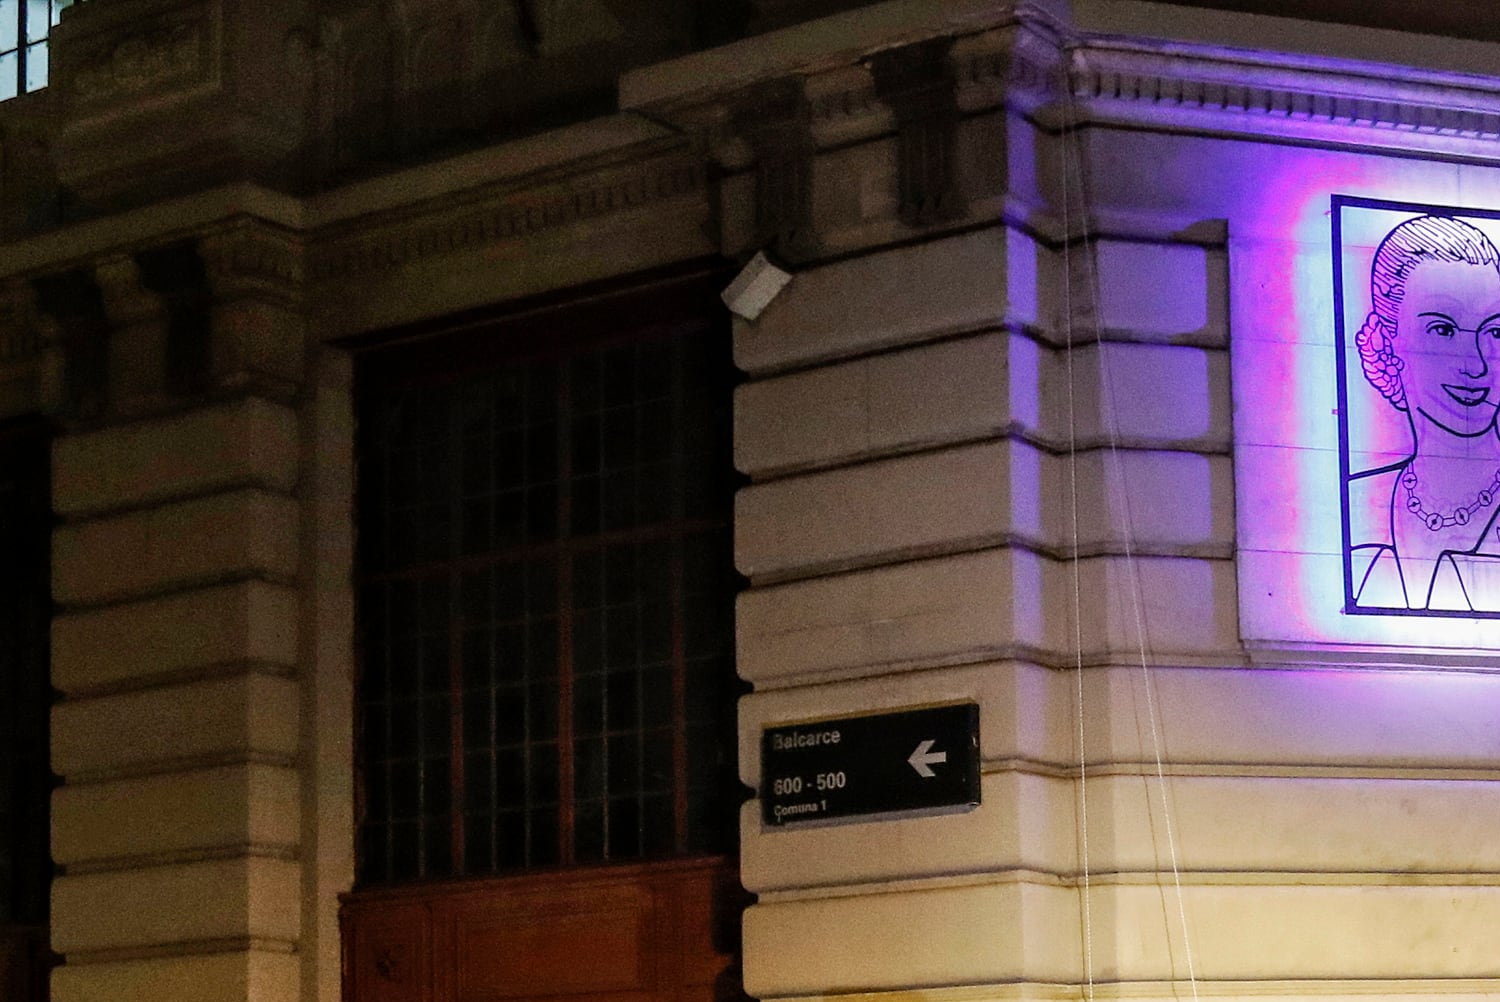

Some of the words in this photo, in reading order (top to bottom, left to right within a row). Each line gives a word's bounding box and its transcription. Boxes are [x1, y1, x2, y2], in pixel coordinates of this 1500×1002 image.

[774, 730, 841, 750] Balcarce
[774, 777, 802, 795] 600
[816, 771, 846, 790] 500
[774, 803, 818, 817] Comuna
[821, 799, 827, 811] 1
